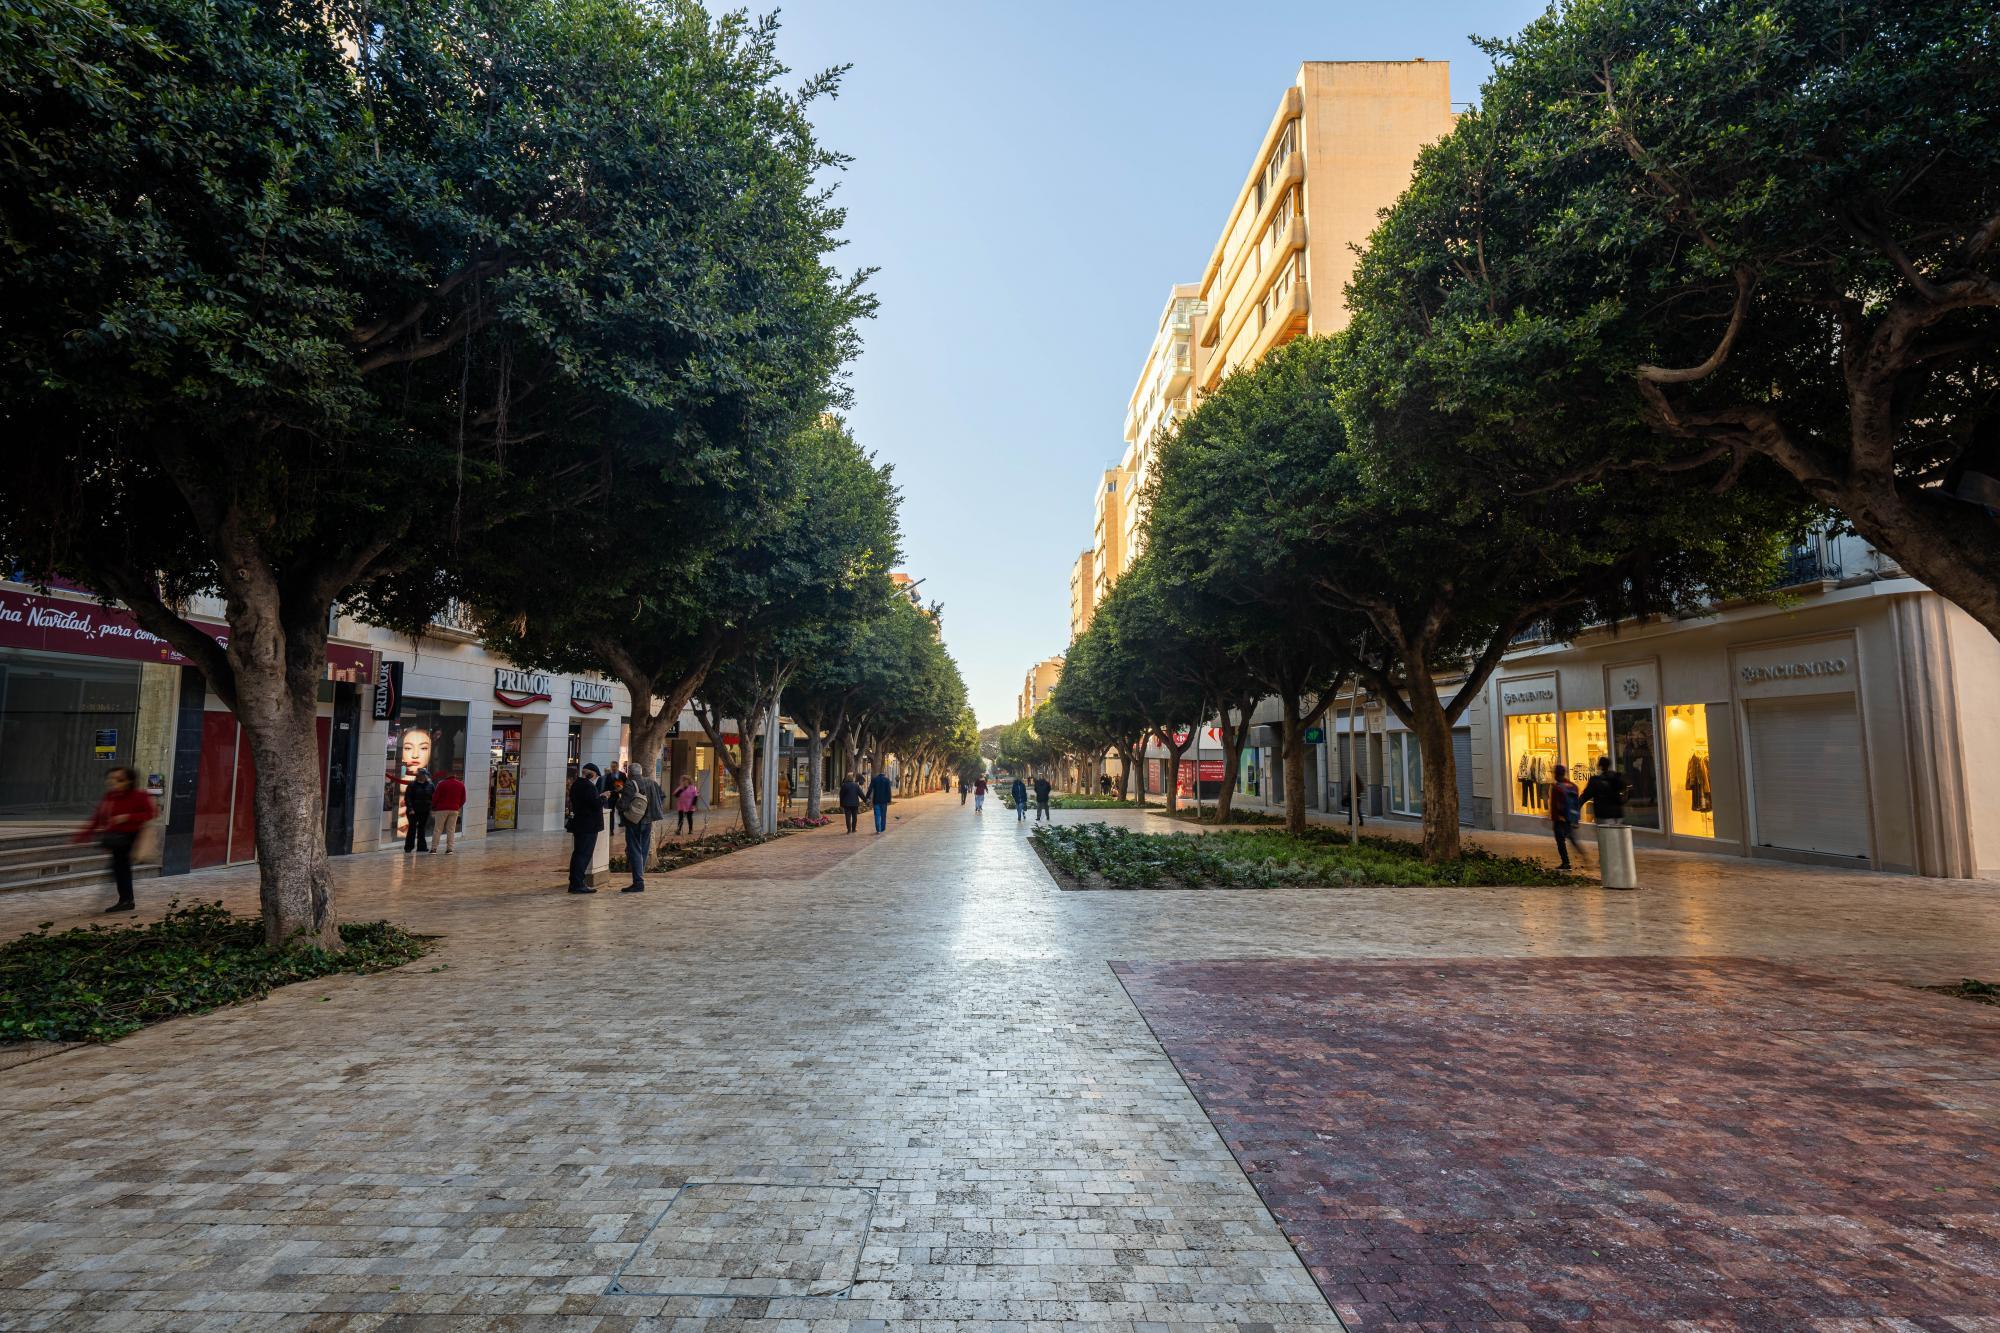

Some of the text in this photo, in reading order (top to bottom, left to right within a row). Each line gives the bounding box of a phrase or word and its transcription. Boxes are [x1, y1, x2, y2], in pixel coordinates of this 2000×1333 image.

[26, 606, 92, 633] Navidad
[99, 624, 133, 638] para
[496, 668, 552, 695] PRIMOR
[1752, 658, 1848, 679] ENCUENTRO
[375, 663, 390, 717] PRIMOR
[571, 681, 613, 703] PRIMOR
